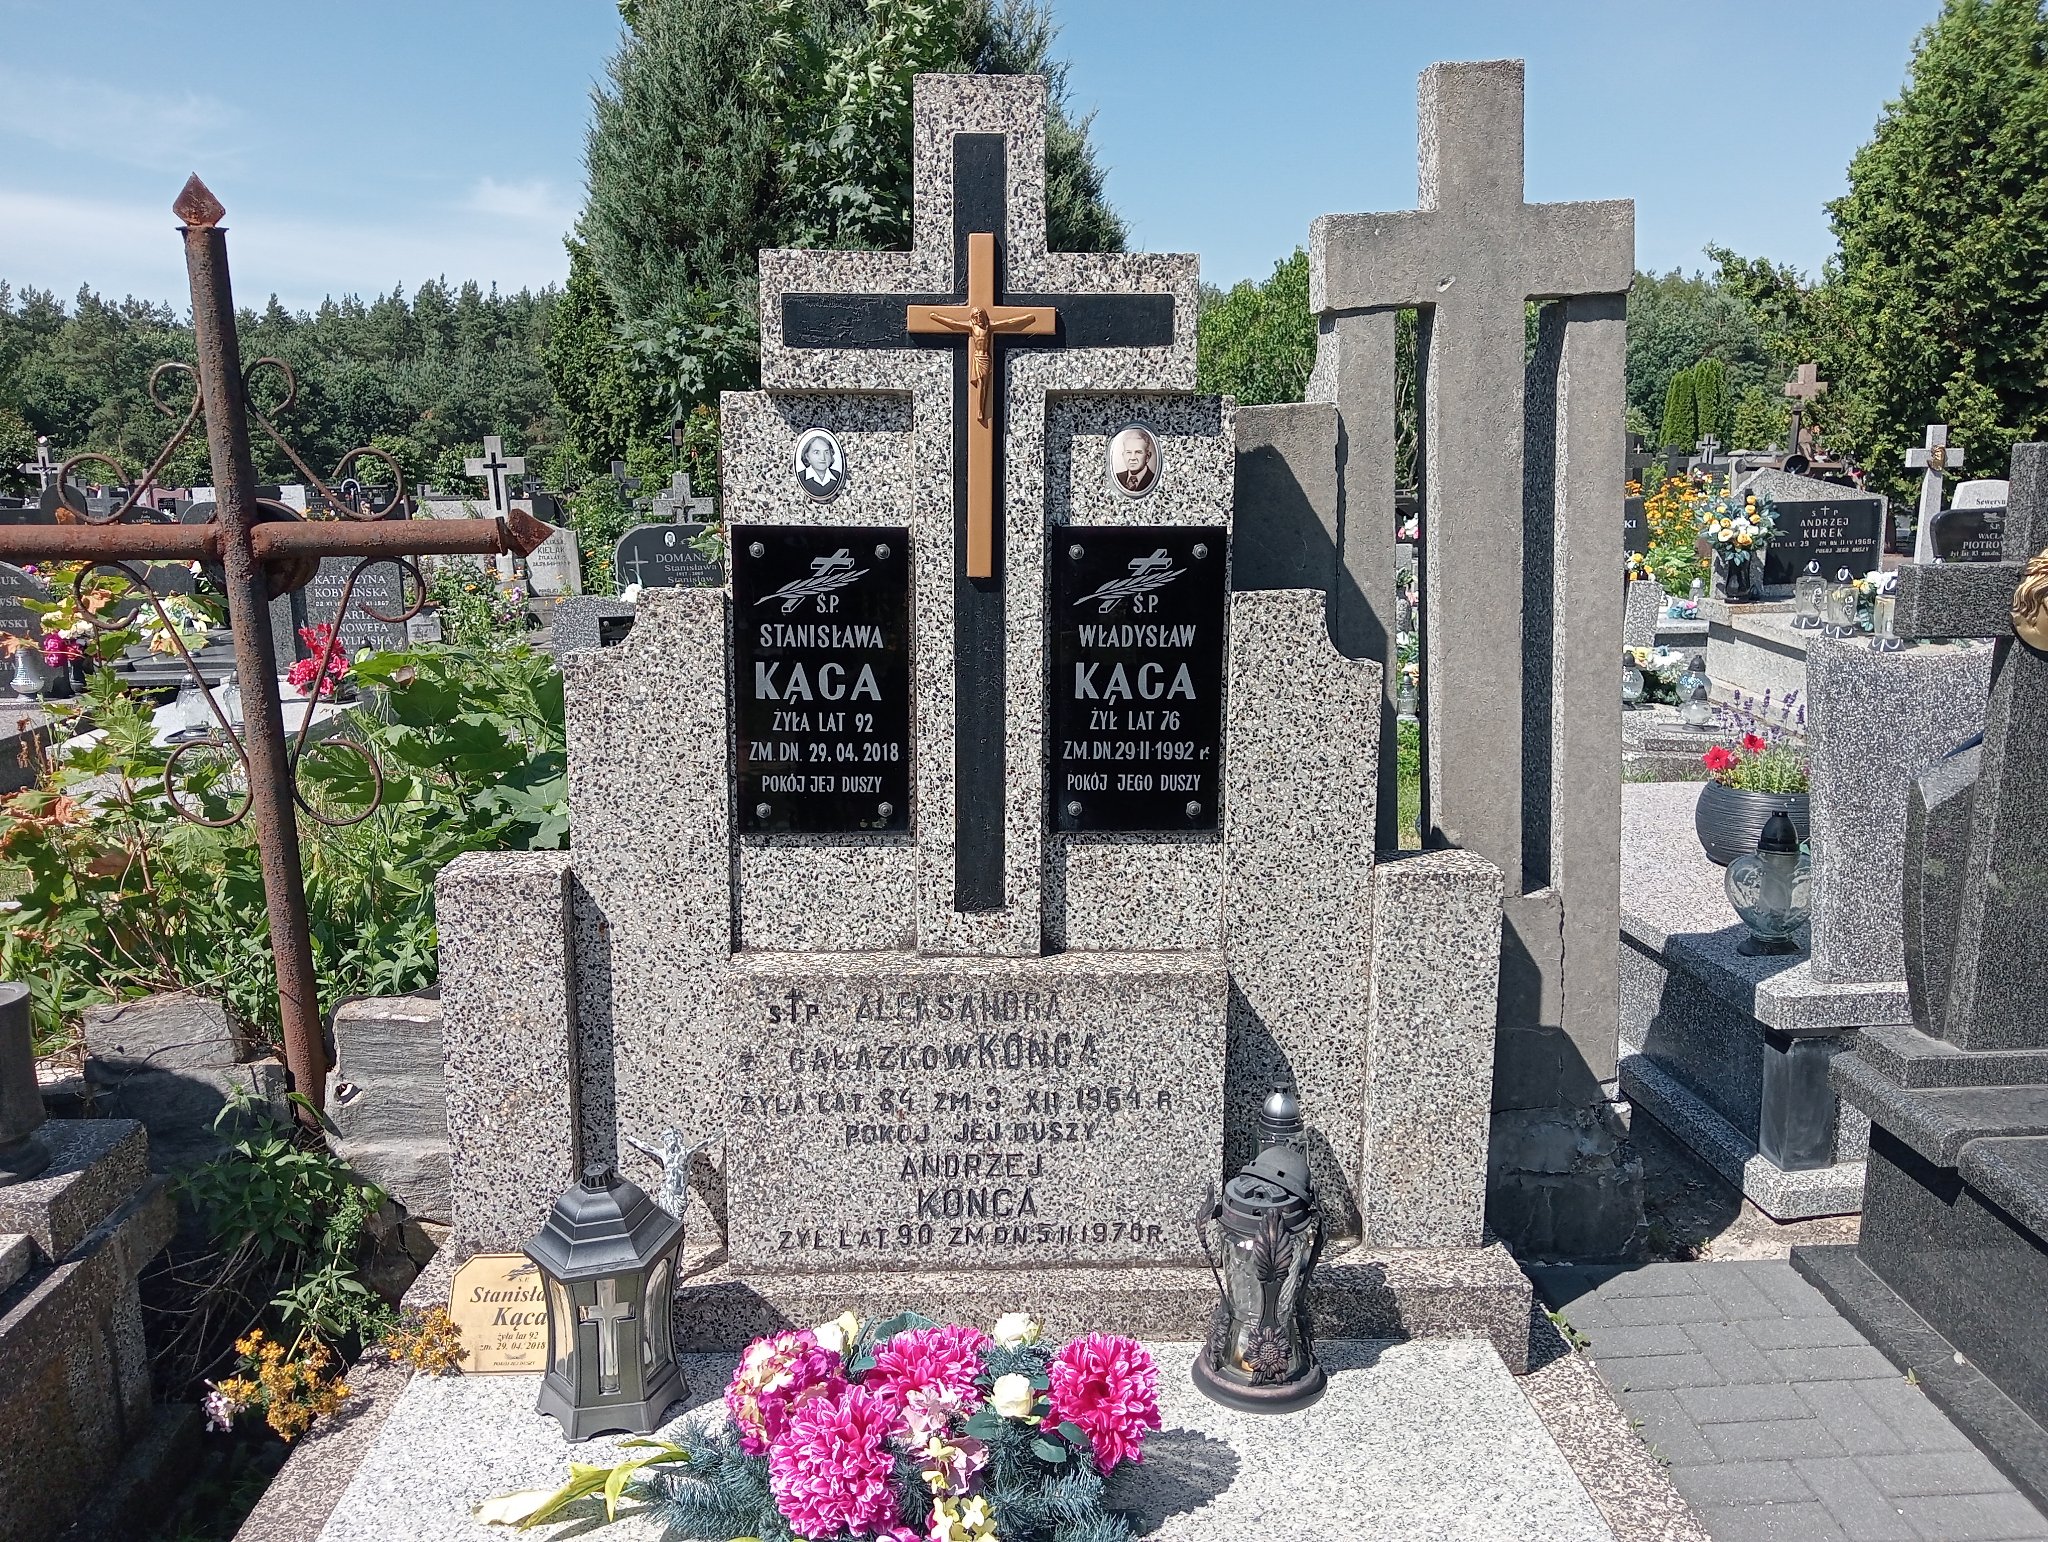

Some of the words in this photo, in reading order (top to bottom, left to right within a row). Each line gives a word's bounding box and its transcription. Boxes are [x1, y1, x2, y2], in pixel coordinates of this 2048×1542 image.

[1800, 517, 1849, 527] ANDRZEJ
[1803, 528, 1843, 539] KUREK
[537, 546, 565, 554] KIELAK
[0, 577, 20, 585] UK
[816, 592, 839, 613] Ś.P.
[1133, 592, 1158, 613] Ś.P.
[331, 623, 389, 632] NOWEFA
[760, 623, 884, 650] STANISŁAWA
[1078, 624, 1197, 648] WŁADYSŁAW
[755, 661, 882, 705] KĄCA
[1074, 662, 1197, 705] KĄCA
[772, 709, 810, 732] ŻYŁA
[818, 712, 846, 732] LAT
[855, 713, 873, 733] 92
[1089, 707, 1118, 730] ŻYŁ
[1128, 711, 1154, 731] LAT
[1160, 711, 1180, 731] 76
[863, 743, 899, 762] 2018
[761, 773, 806, 793] POKÓJ
[810, 775, 835, 793] JEJ
[842, 776, 883, 793] DUSZY
[1067, 771, 1108, 791] POKÓJ
[1117, 774, 1153, 792] JEGO
[1160, 774, 1201, 792] DUSZY
[1014, 1122, 1099, 1144] DUSZY
[900, 1153, 1044, 1182] ANDRZEJ
[839, 1228, 889, 1250] LAT
[898, 1224, 933, 1247] 90
[492, 1306, 548, 1331] Kąca
[525, 1341, 546, 1350] 2018
[529, 1331, 539, 1340] 92
